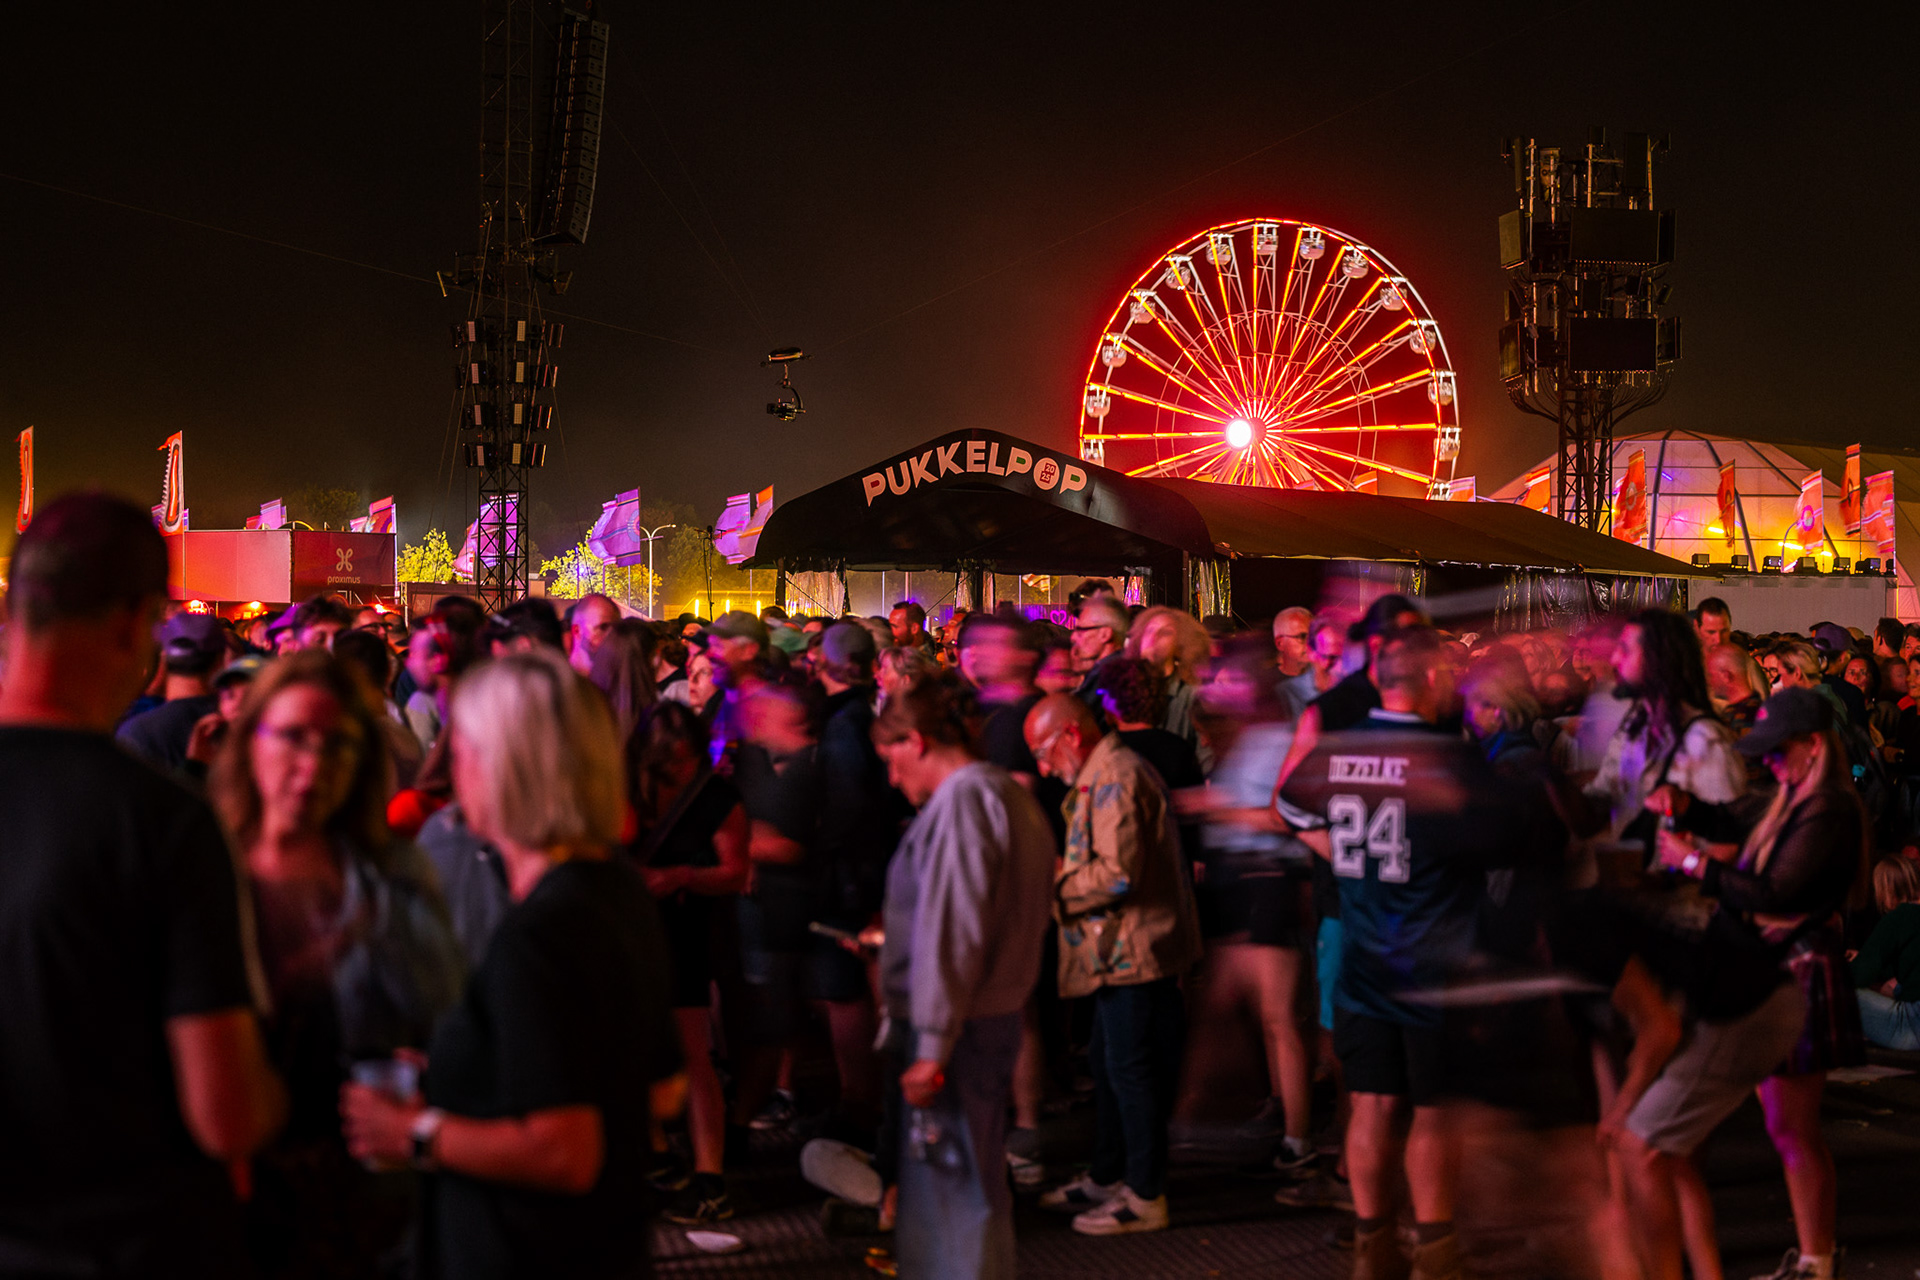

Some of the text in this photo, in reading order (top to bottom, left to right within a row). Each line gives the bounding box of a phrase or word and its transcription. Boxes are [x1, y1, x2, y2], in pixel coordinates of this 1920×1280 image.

[862, 441, 1087, 507] PUKKELPOP
[1045, 464, 1055, 474] 20
[1041, 472, 1050, 482] 25
[327, 575, 361, 585] proximus
[1327, 794, 1412, 884] 24
